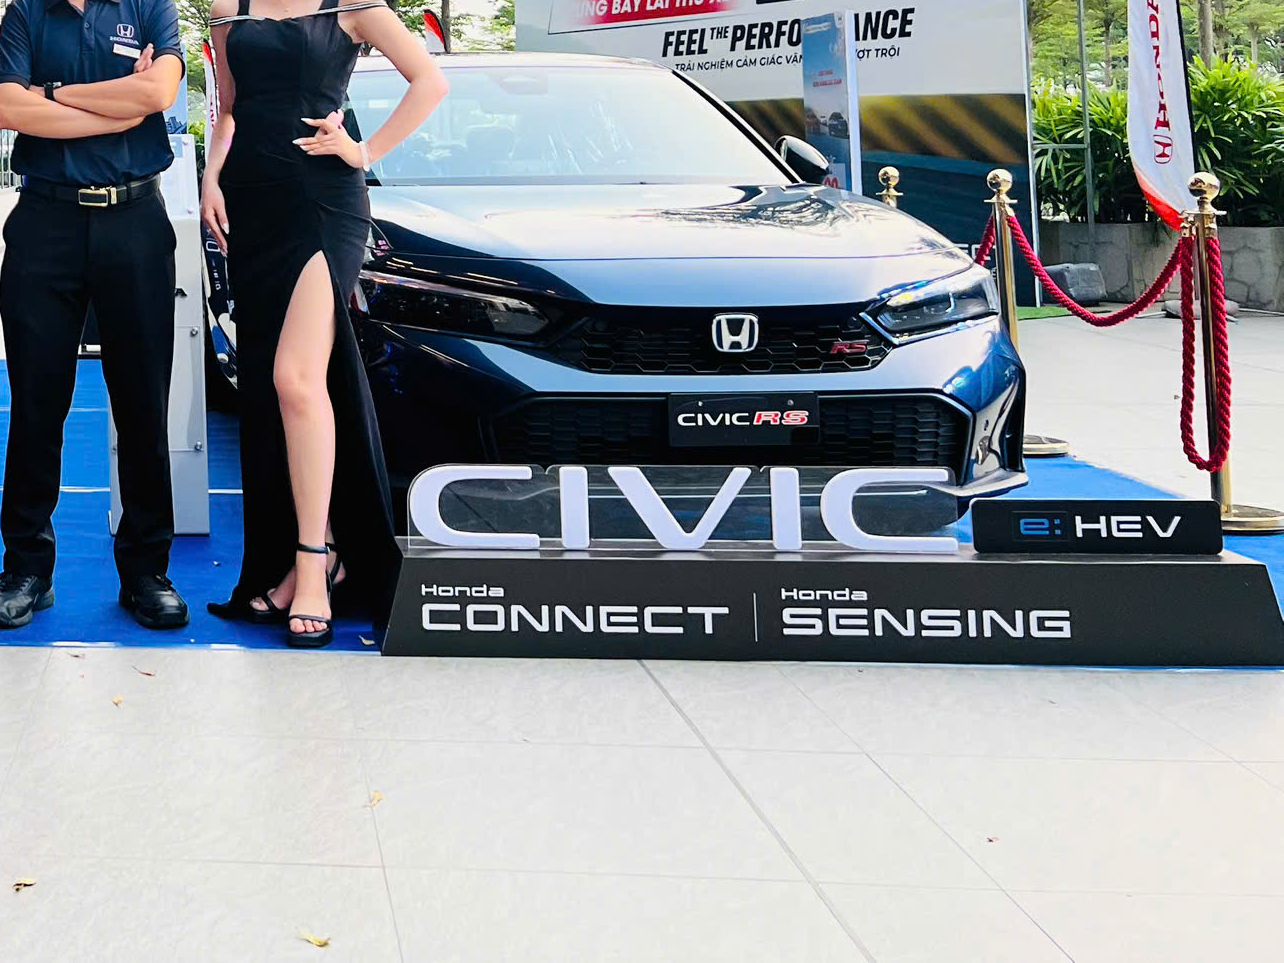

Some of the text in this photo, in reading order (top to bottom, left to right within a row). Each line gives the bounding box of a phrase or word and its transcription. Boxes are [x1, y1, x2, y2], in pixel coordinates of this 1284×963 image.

[109, 36, 139, 45] HONDA
[662, 7, 916, 58] FEEL THE PERFONCE
[697, 57, 734, 71] NGHIỆM
[736, 55, 758, 69] CẢM
[759, 53, 783, 66] GIÁC
[875, 45, 901, 59] TRỘI
[830, 341, 869, 354] RS
[410, 465, 959, 553] CIVIC
[421, 584, 504, 598] Honda
[781, 588, 869, 602] Honda
[421, 604, 730, 635] CONNECT
[782, 608, 1073, 638] SENSING
